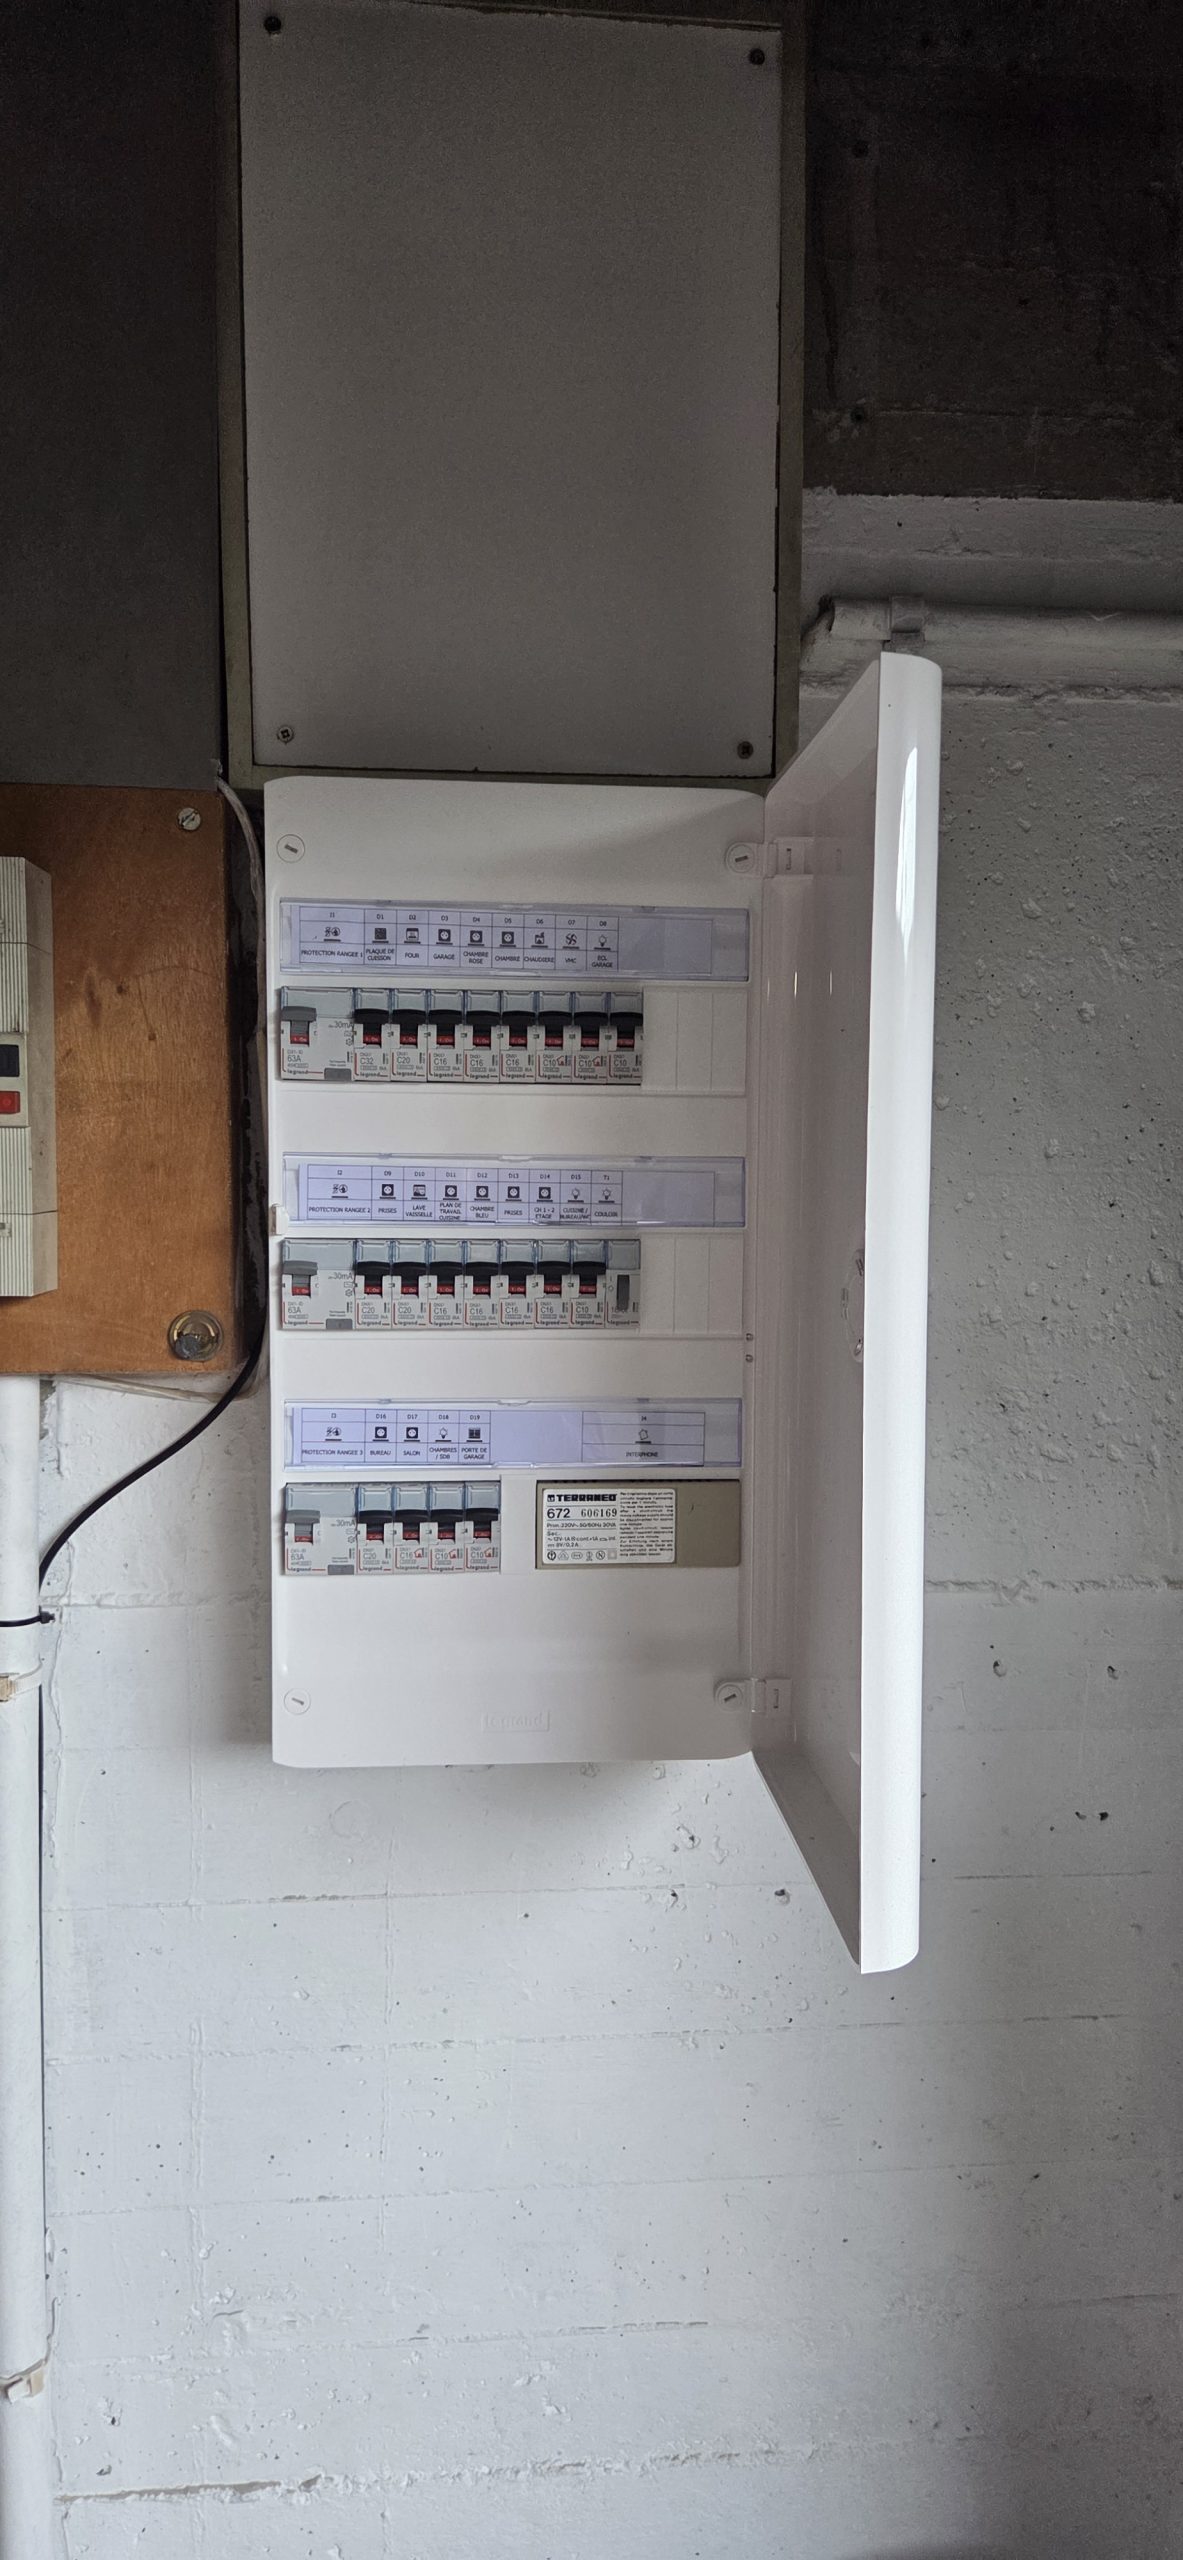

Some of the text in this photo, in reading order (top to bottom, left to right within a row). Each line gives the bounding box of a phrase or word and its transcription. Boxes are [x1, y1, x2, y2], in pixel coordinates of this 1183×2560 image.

[334, 1020, 353, 1029] 30mA
[287, 1054, 301, 1062] 63A
[360, 1057, 374, 1065] C32
[396, 1056, 410, 1064] C20
[434, 1058, 447, 1066] C16
[470, 1059, 484, 1067] C16
[506, 1059, 520, 1067] C16
[543, 1059, 557, 1067] C10
[578, 1060, 592, 1068] C10
[613, 1059, 627, 1067] C10
[334, 1272, 353, 1280] 30mA
[287, 1306, 301, 1314] 63A
[362, 1306, 375, 1314] C20
[398, 1306, 412, 1314] C20
[434, 1307, 447, 1315] C16
[505, 1306, 519, 1314] C16
[540, 1306, 554, 1314] C16
[576, 1306, 589, 1314] C10
[556, 1494, 617, 1502] TERRANEO
[547, 1508, 617, 1518] 672 606169
[336, 1519, 355, 1527] 30mA
[363, 1552, 377, 1560] C20
[435, 1552, 448, 1560] C10
[470, 1551, 484, 1559] C10
